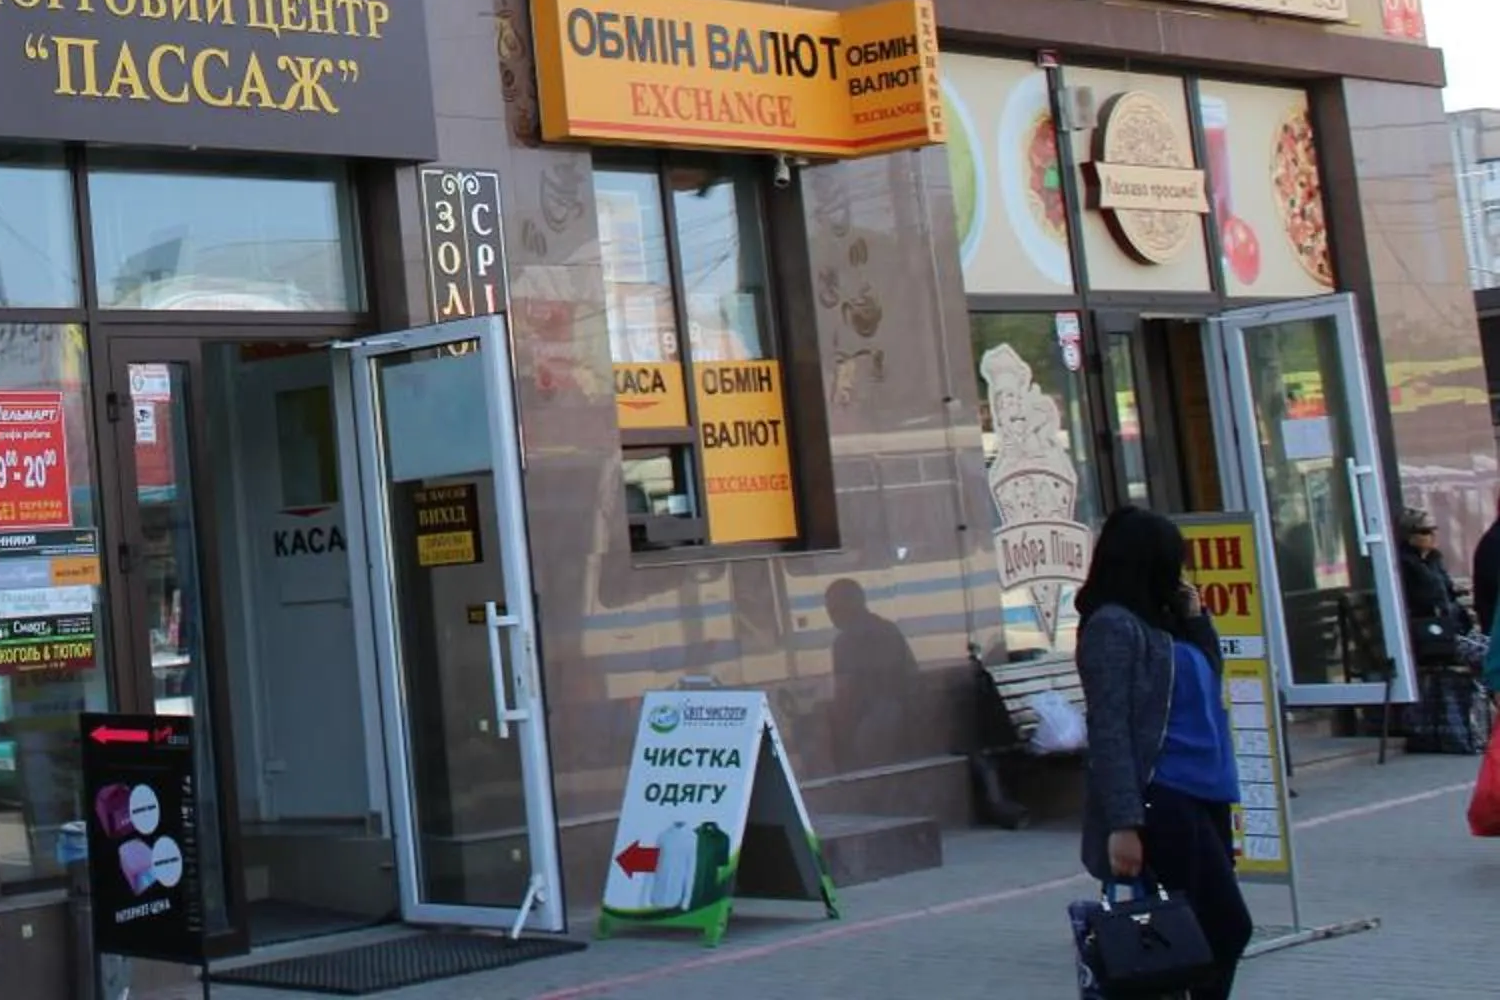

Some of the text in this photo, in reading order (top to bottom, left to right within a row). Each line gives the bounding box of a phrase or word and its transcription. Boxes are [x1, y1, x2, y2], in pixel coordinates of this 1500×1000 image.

[567, 8, 841, 80] ОБМІН ВАЛЮТ
[846, 34, 918, 67] ОБМІН
[849, 65, 921, 97] ВАЛЮТ
[630, 82, 796, 129] EXCHANGE
[702, 366, 773, 396] ОБМІН
[701, 418, 781, 450] ВАЛЮТ
[707, 473, 789, 494] EXCHANGE
[273, 525, 346, 557] КАСА
[643, 748, 741, 768] ЧИСТКА
[644, 783, 727, 807] ОДЯГУ
